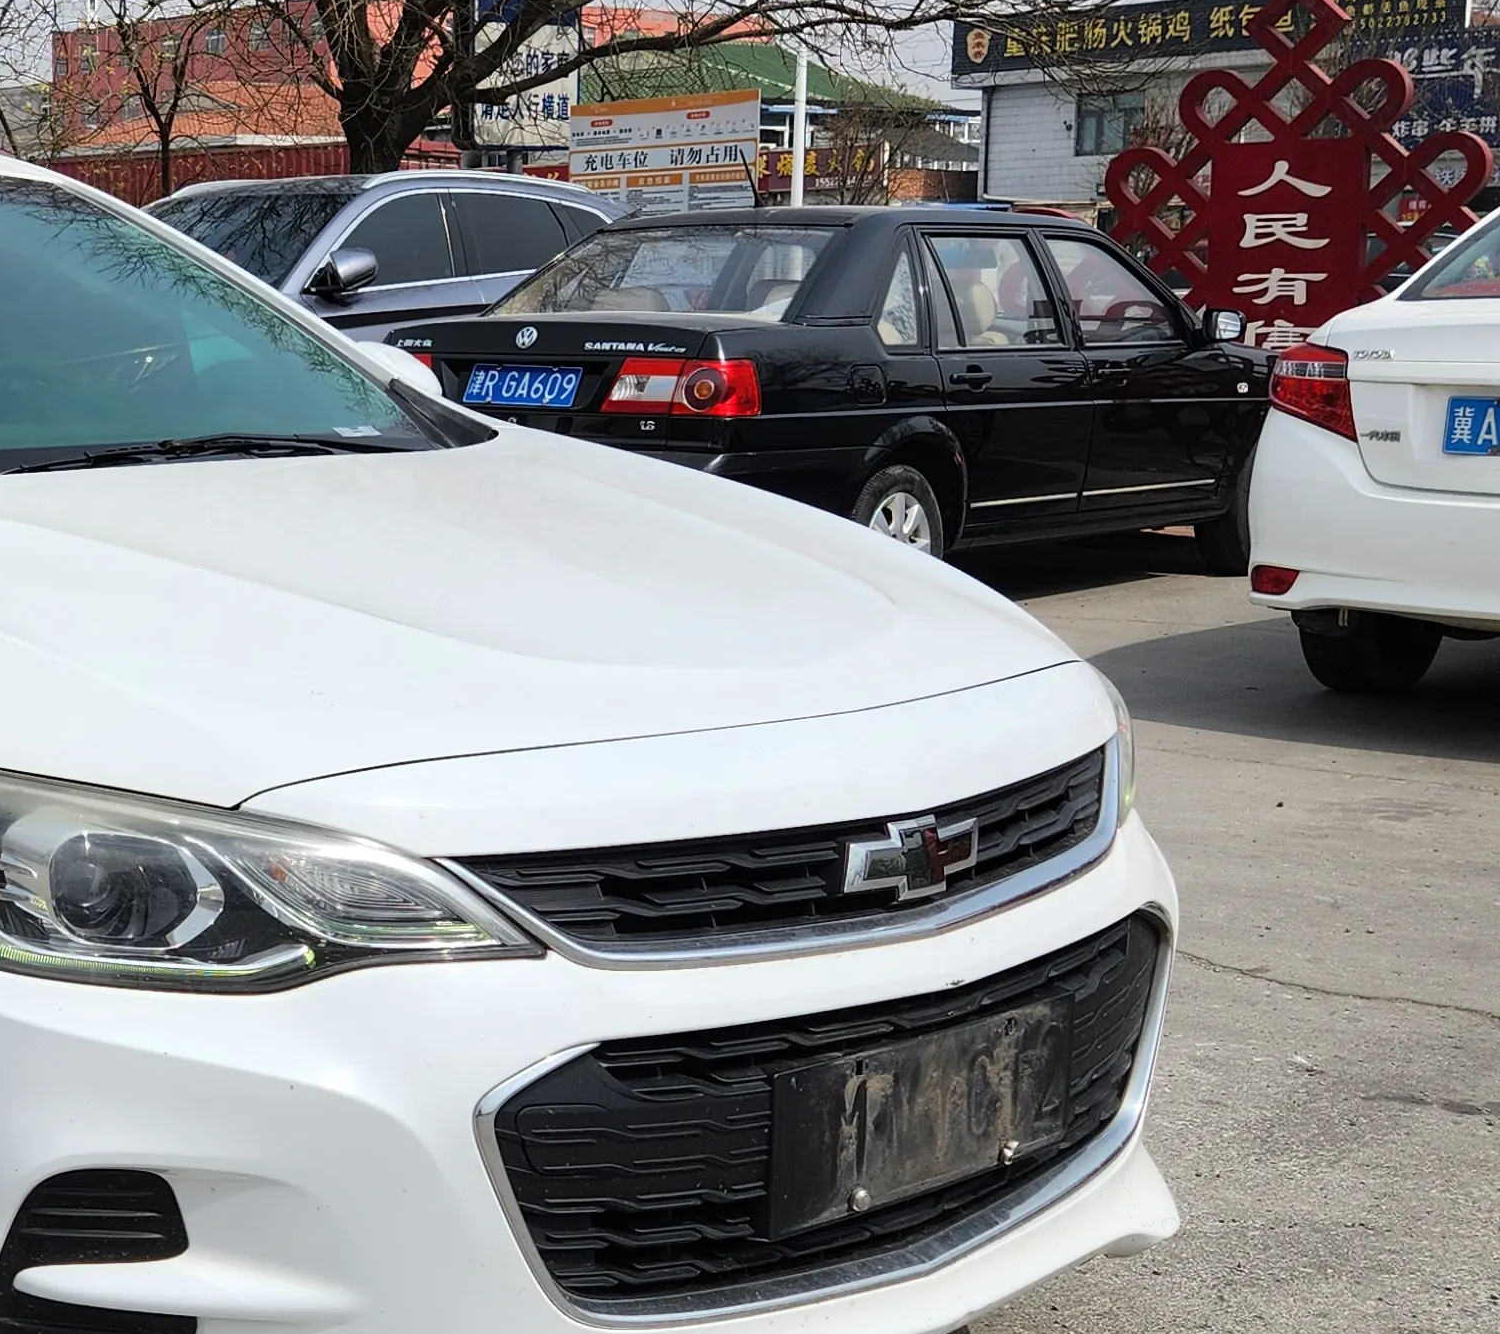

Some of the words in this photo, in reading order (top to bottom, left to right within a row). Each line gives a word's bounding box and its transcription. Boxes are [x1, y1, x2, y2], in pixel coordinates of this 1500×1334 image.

[1209, 4, 1294, 39] 纸包
[583, 150, 649, 173] 充电车位
[669, 144, 739, 166] 请勿占用
[583, 341, 645, 352] SANTANA
